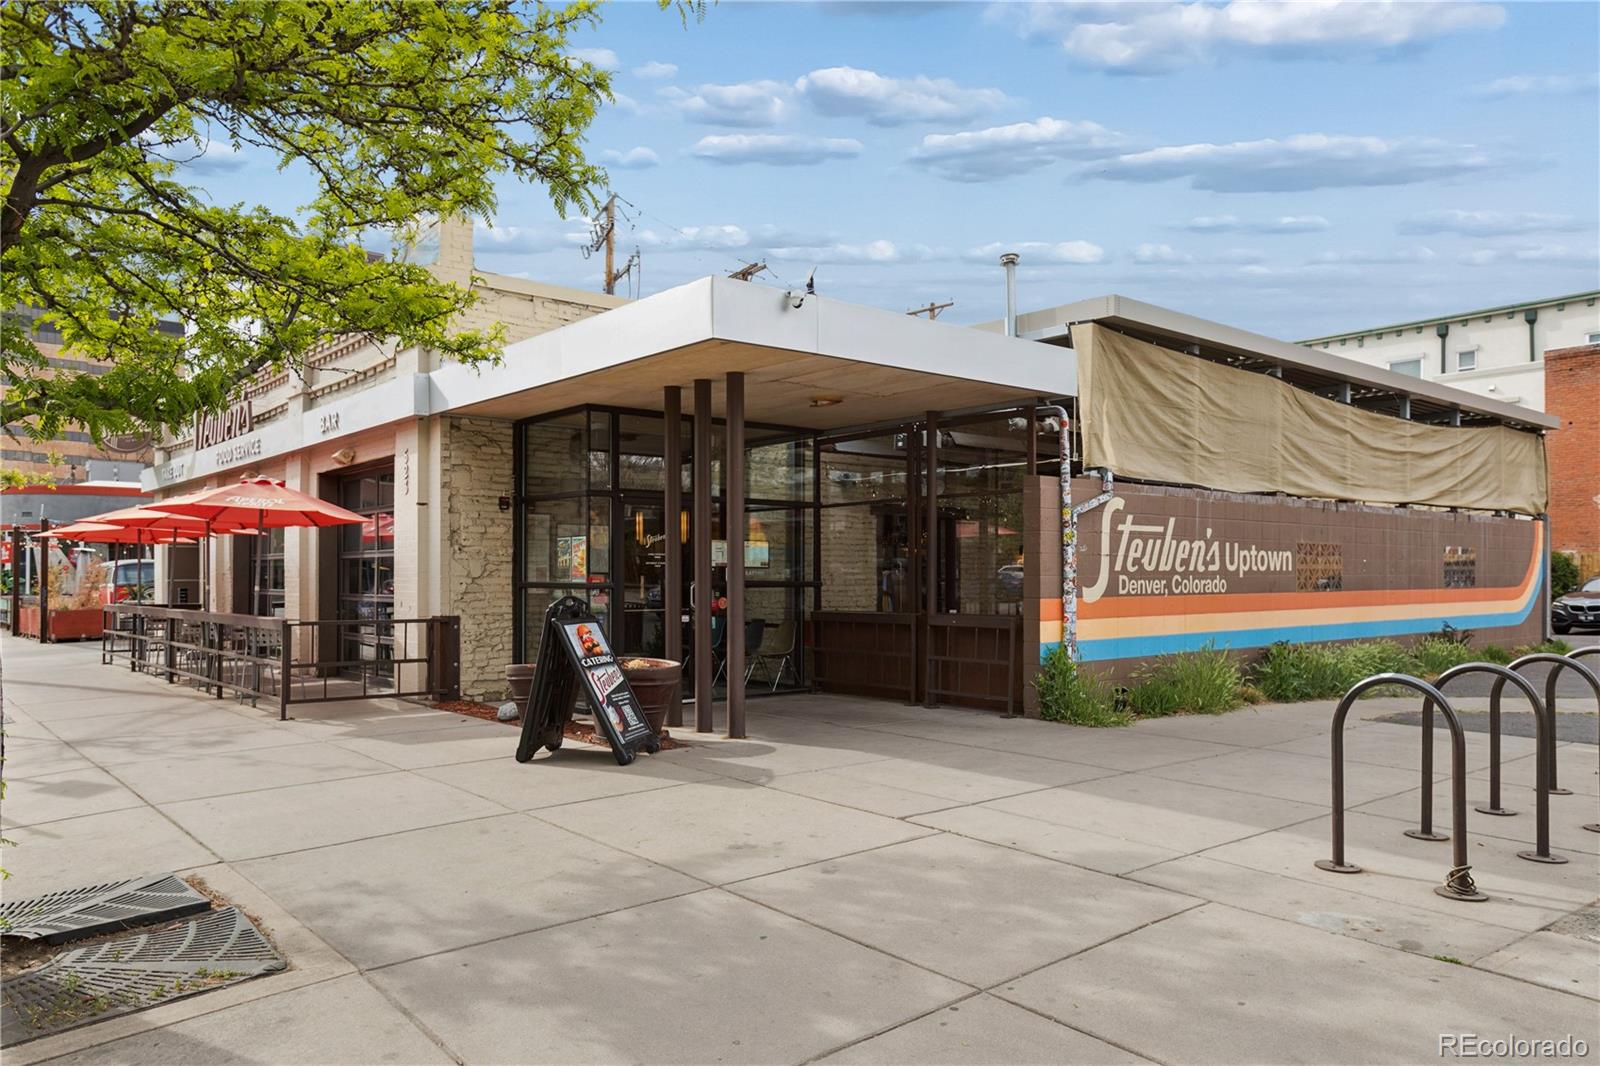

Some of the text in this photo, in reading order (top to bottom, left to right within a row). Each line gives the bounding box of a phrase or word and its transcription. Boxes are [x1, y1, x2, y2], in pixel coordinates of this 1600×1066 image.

[320, 411, 340, 434] BAR
[1082, 497, 1293, 604] Steuben's Uptown
[1118, 574, 1227, 597] Denver, Colorado
[581, 655, 614, 668] CATERING
